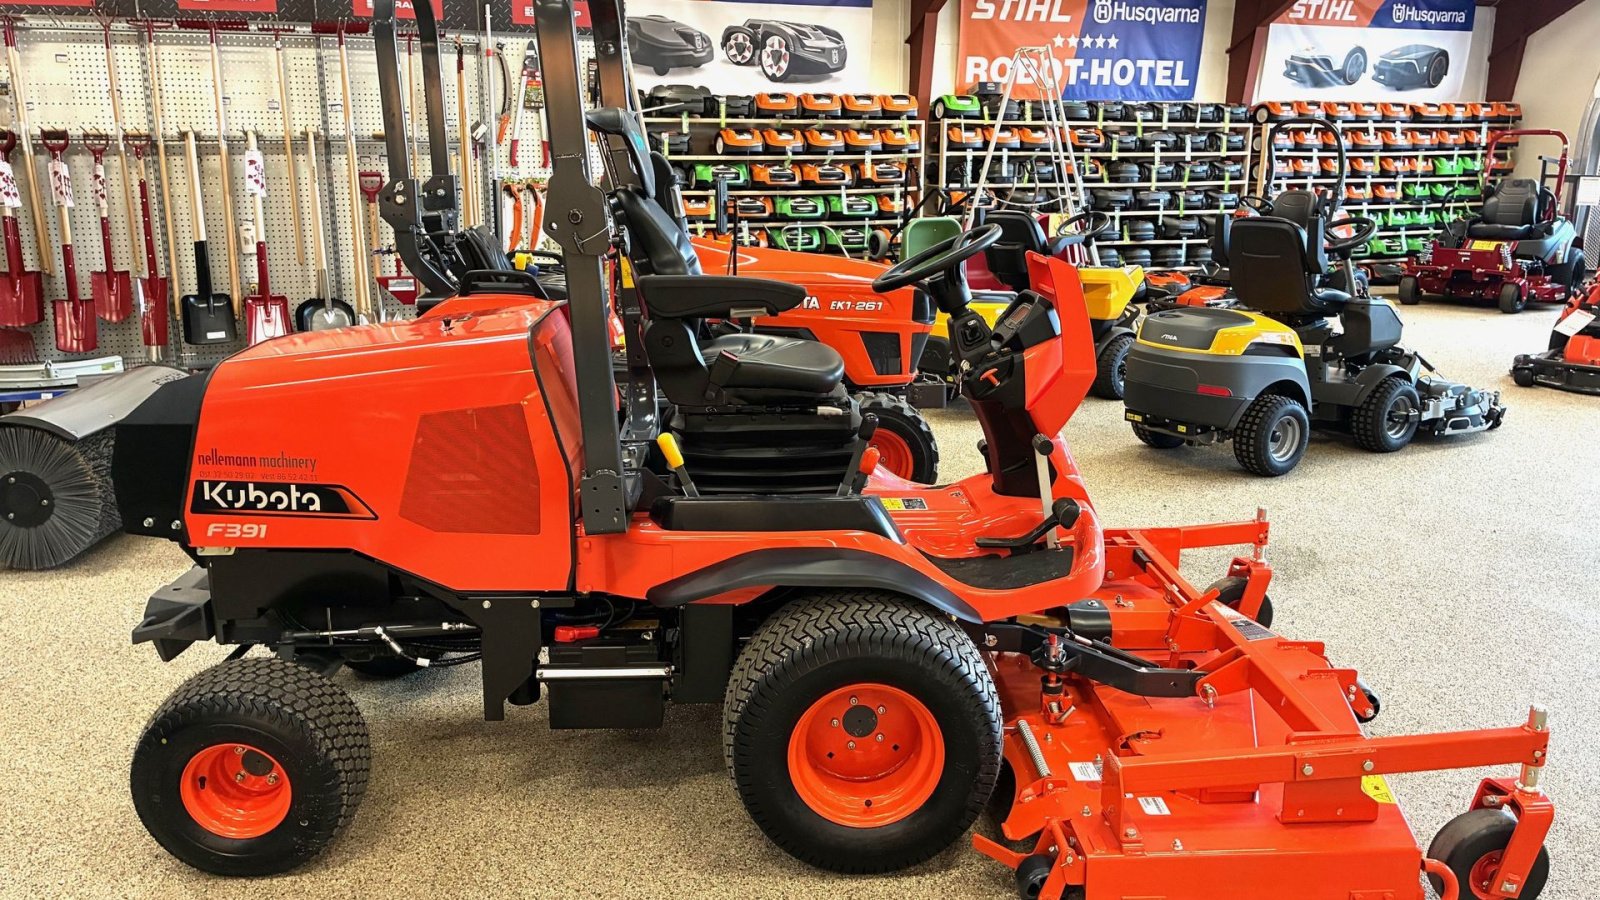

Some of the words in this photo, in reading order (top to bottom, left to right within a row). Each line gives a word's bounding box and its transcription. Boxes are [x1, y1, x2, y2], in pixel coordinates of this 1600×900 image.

[970, 0, 1073, 23] STIHL
[1113, 0, 1200, 25] Husqvarna
[1288, 0, 1359, 21] STIHL
[1405, 8, 1466, 25] Husqvarna
[965, 55, 1190, 88] ROBOT-HOTEL
[794, 297, 820, 309] TA
[830, 302, 883, 310] EK1-261
[198, 448, 257, 467] nellemann
[259, 450, 317, 473] machinery
[203, 481, 321, 511] Kubota
[207, 523, 267, 538] F391
